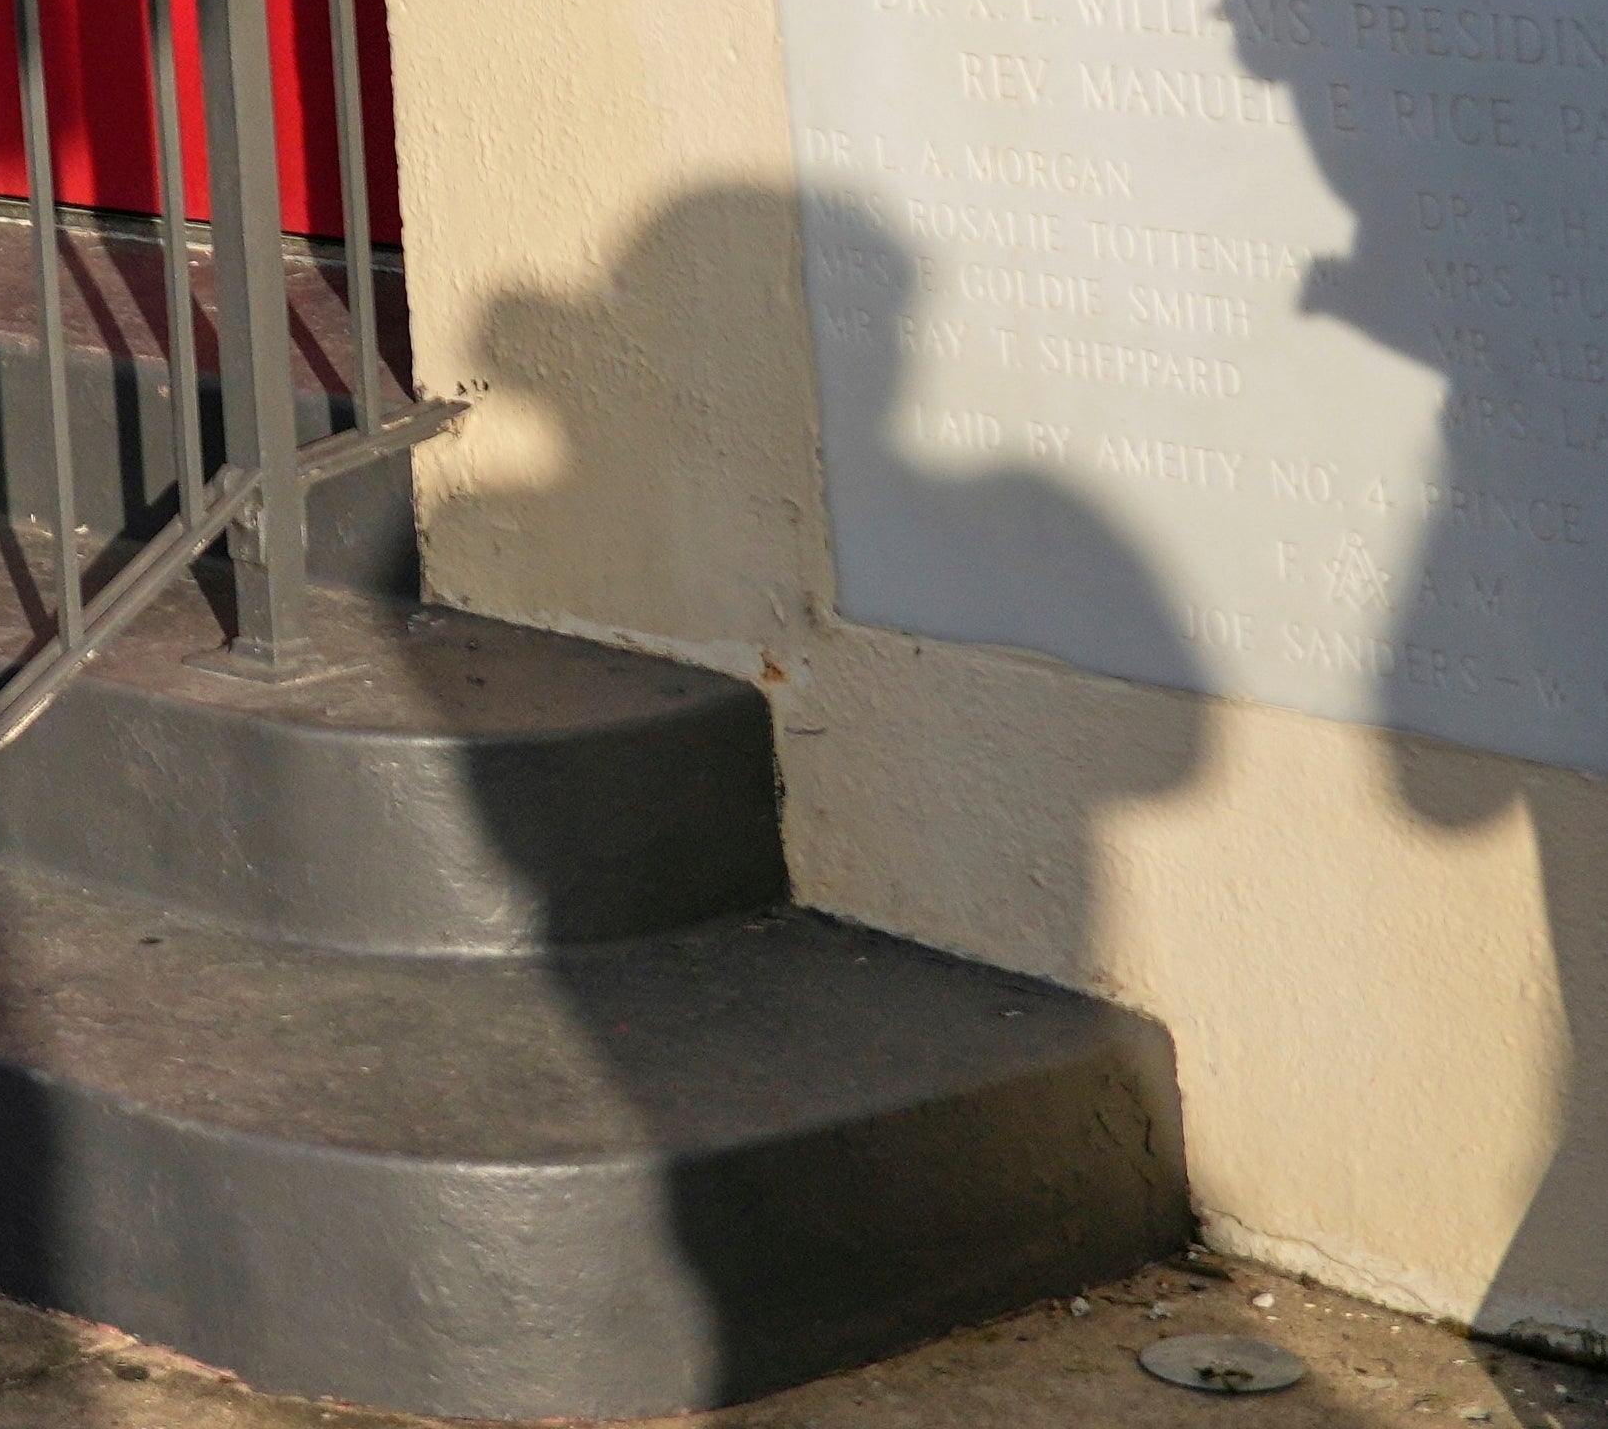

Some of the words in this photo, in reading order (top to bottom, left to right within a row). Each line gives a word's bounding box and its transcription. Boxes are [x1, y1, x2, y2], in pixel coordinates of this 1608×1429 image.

[959, 50, 1055, 106] REV.
[1079, 60, 1293, 127] MANUEL
[805, 126, 865, 174] DR.
[874, 133, 907, 174] L.
[920, 140, 956, 182] A.
[965, 143, 1135, 200] MORGAN
[908, 197, 1063, 255] ROSALIE
[1082, 218, 1339, 286] TOTTENHAM
[959, 261, 1103, 318] GOLDIE
[1127, 283, 1252, 341] SMITH
[896, 314, 968, 361] RAY
[1039, 332, 1242, 400] SHEPPARD
[913, 402, 1003, 454] LAID
[1024, 419, 1073, 466] BY
[1422, 479, 1587, 546] PRINCE
[1181, 602, 1256, 652] JOE
[1280, 620, 1480, 695] SANDERS
